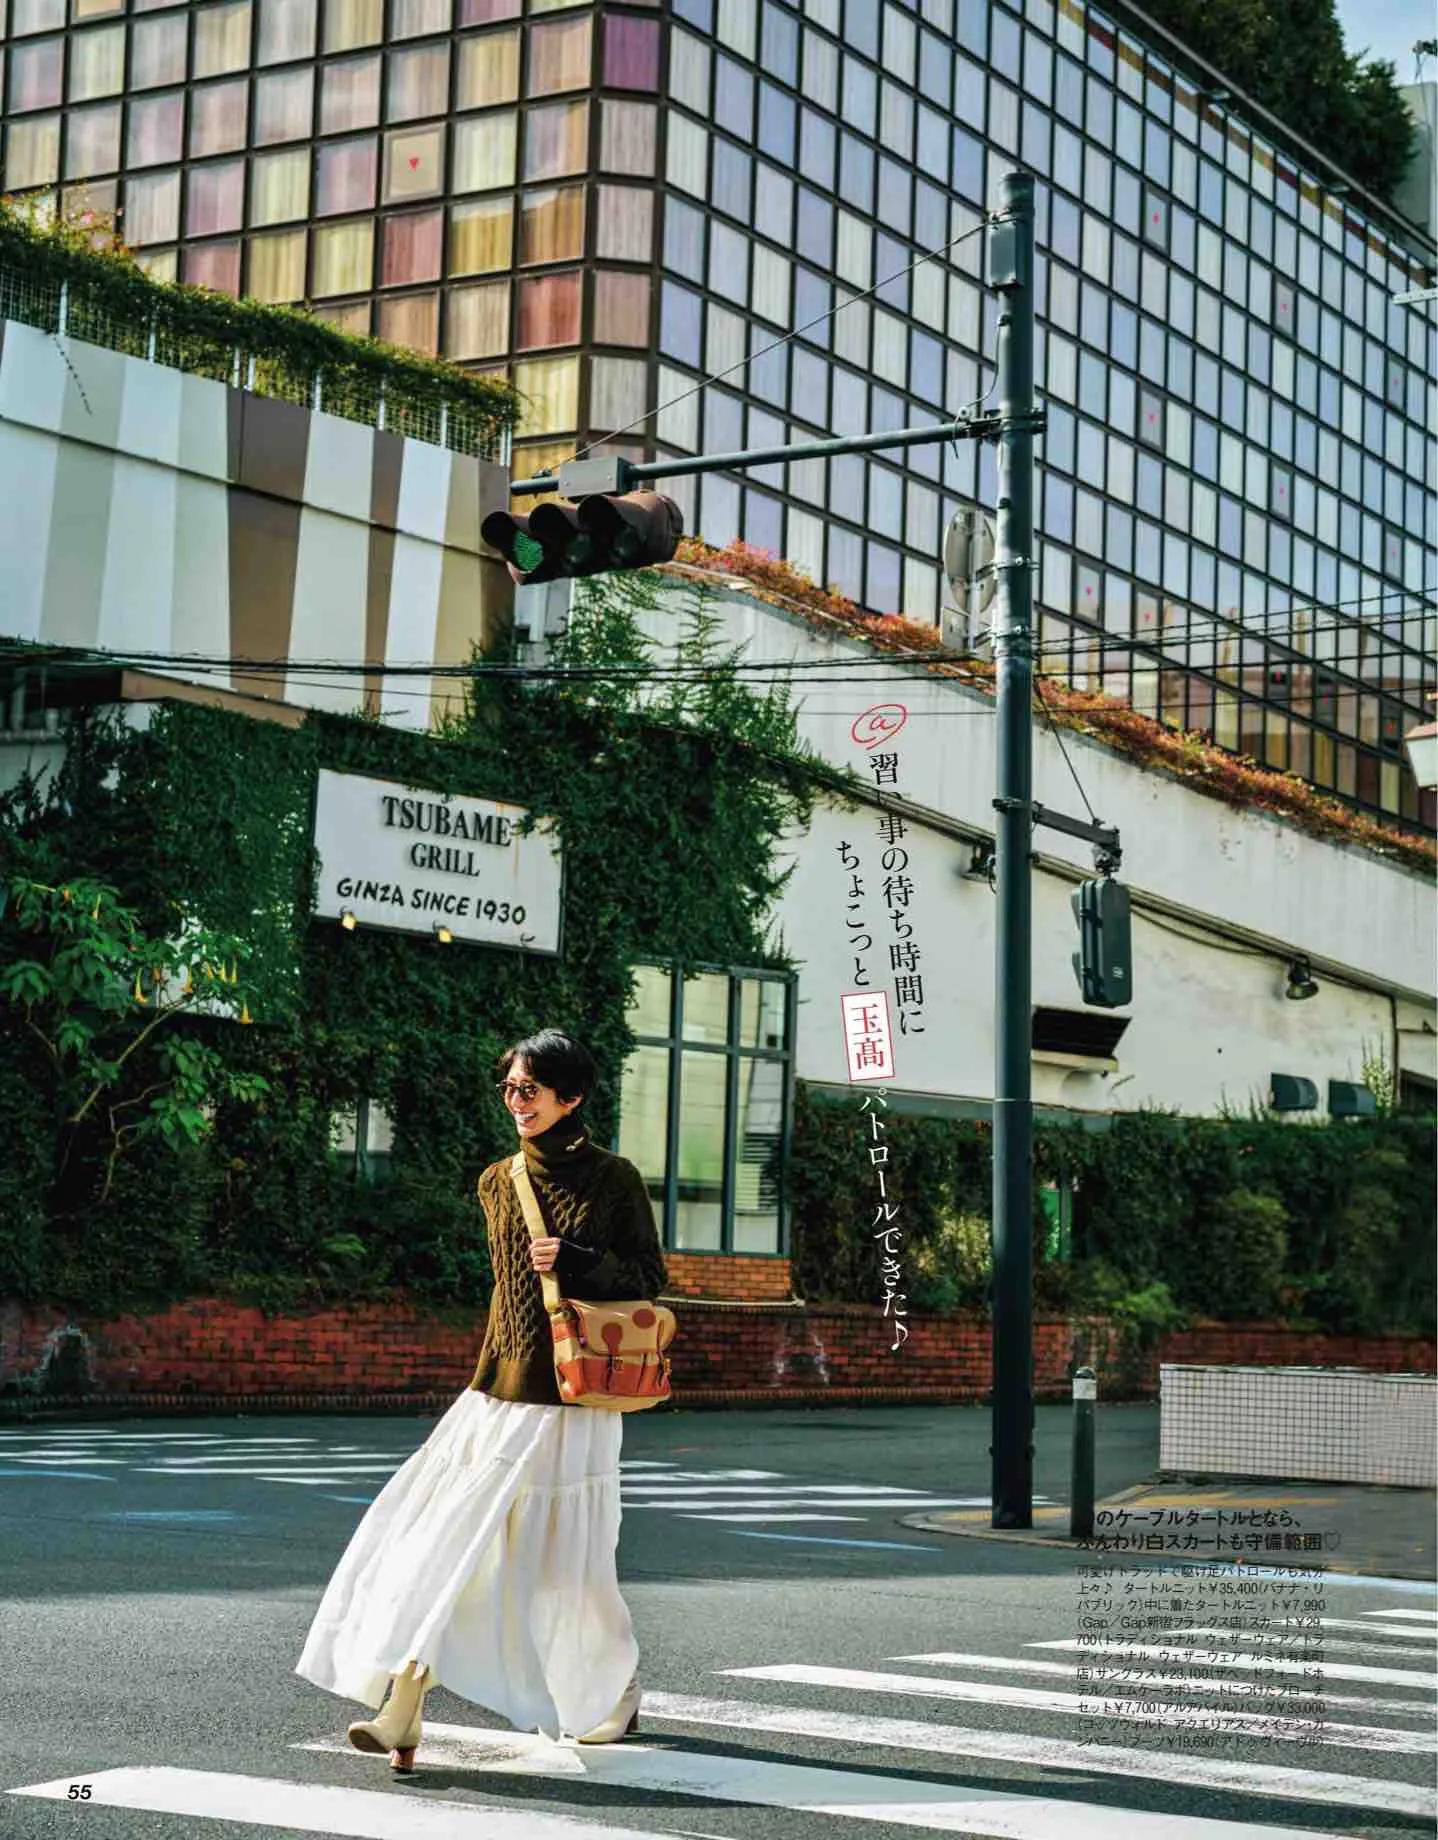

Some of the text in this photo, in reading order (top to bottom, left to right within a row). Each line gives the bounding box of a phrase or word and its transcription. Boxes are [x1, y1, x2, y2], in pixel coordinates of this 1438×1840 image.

[382, 795, 512, 847] TSUBAME
[410, 843, 481, 877] GRILL
[336, 878, 527, 925] GINZA SINCE 1930
